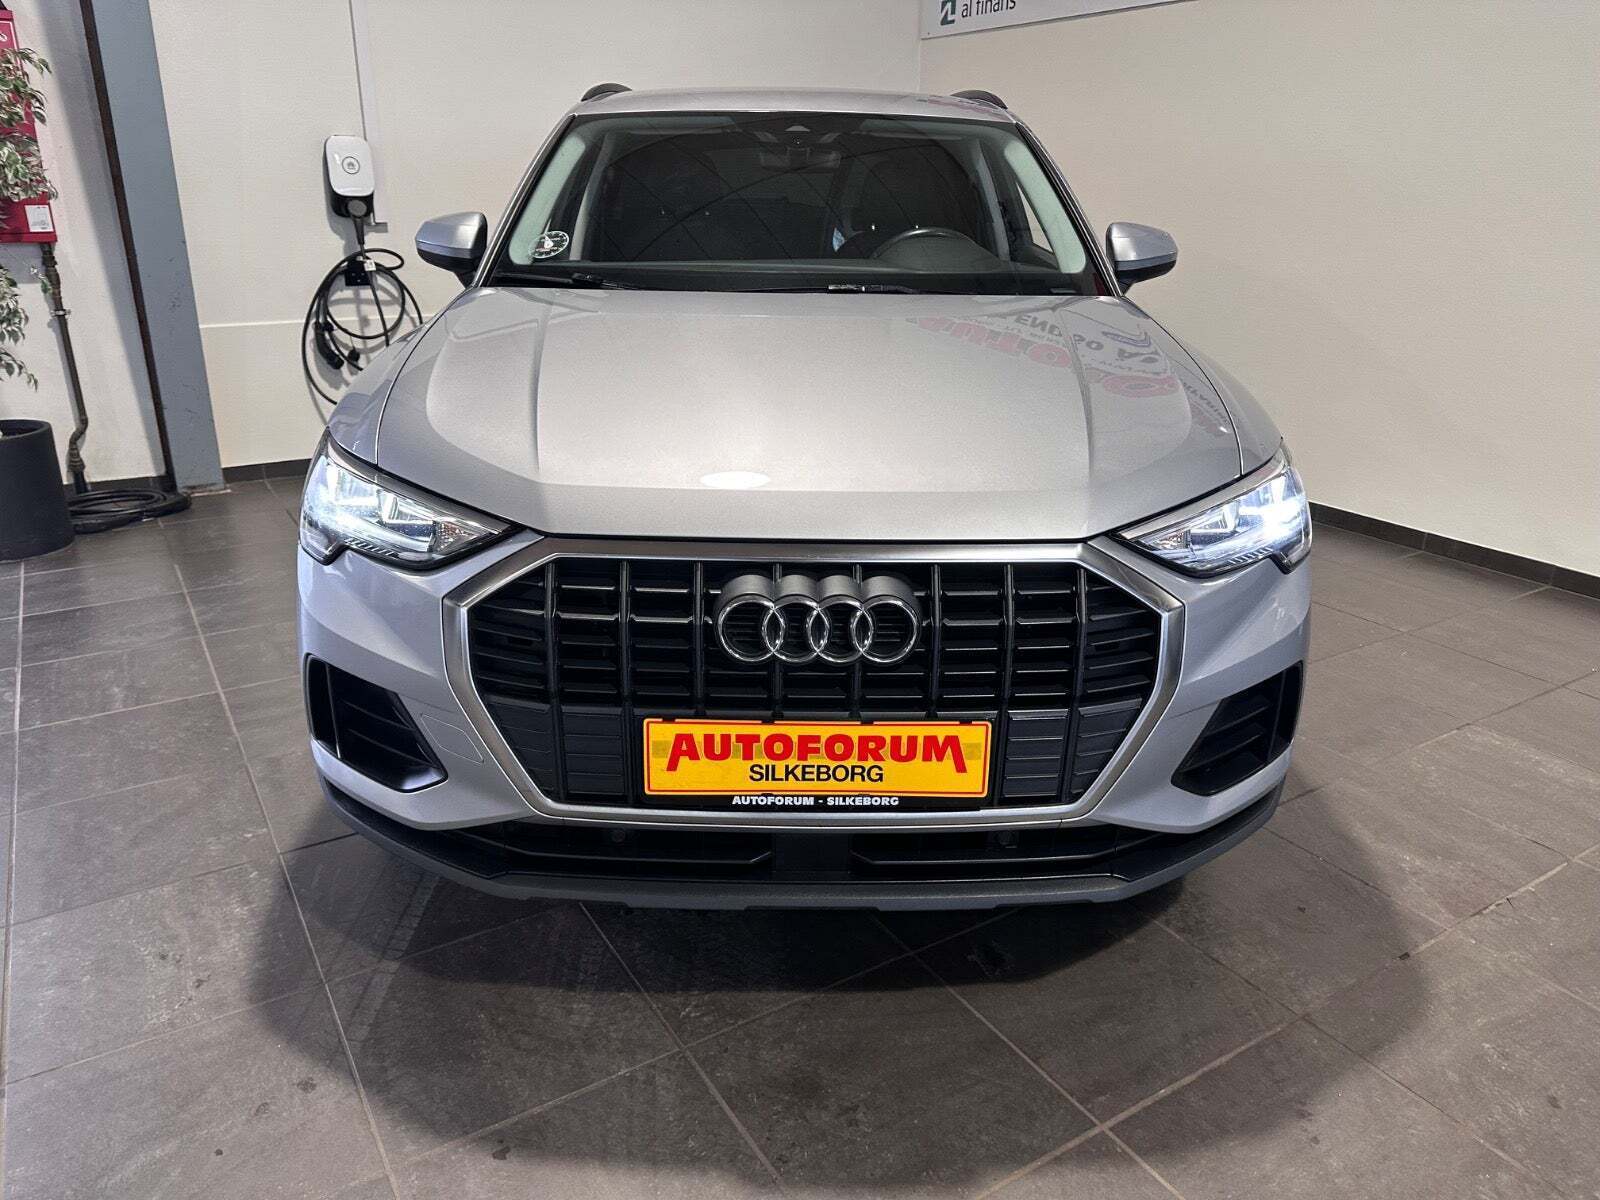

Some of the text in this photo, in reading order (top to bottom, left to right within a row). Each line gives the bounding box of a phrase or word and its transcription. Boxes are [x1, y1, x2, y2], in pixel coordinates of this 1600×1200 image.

[666, 733, 968, 774] AUTOFORUM
[749, 764, 884, 783] SILKEBORG
[732, 796, 815, 806] AUTOFORUM
[826, 796, 900, 806] SILKEBORG
